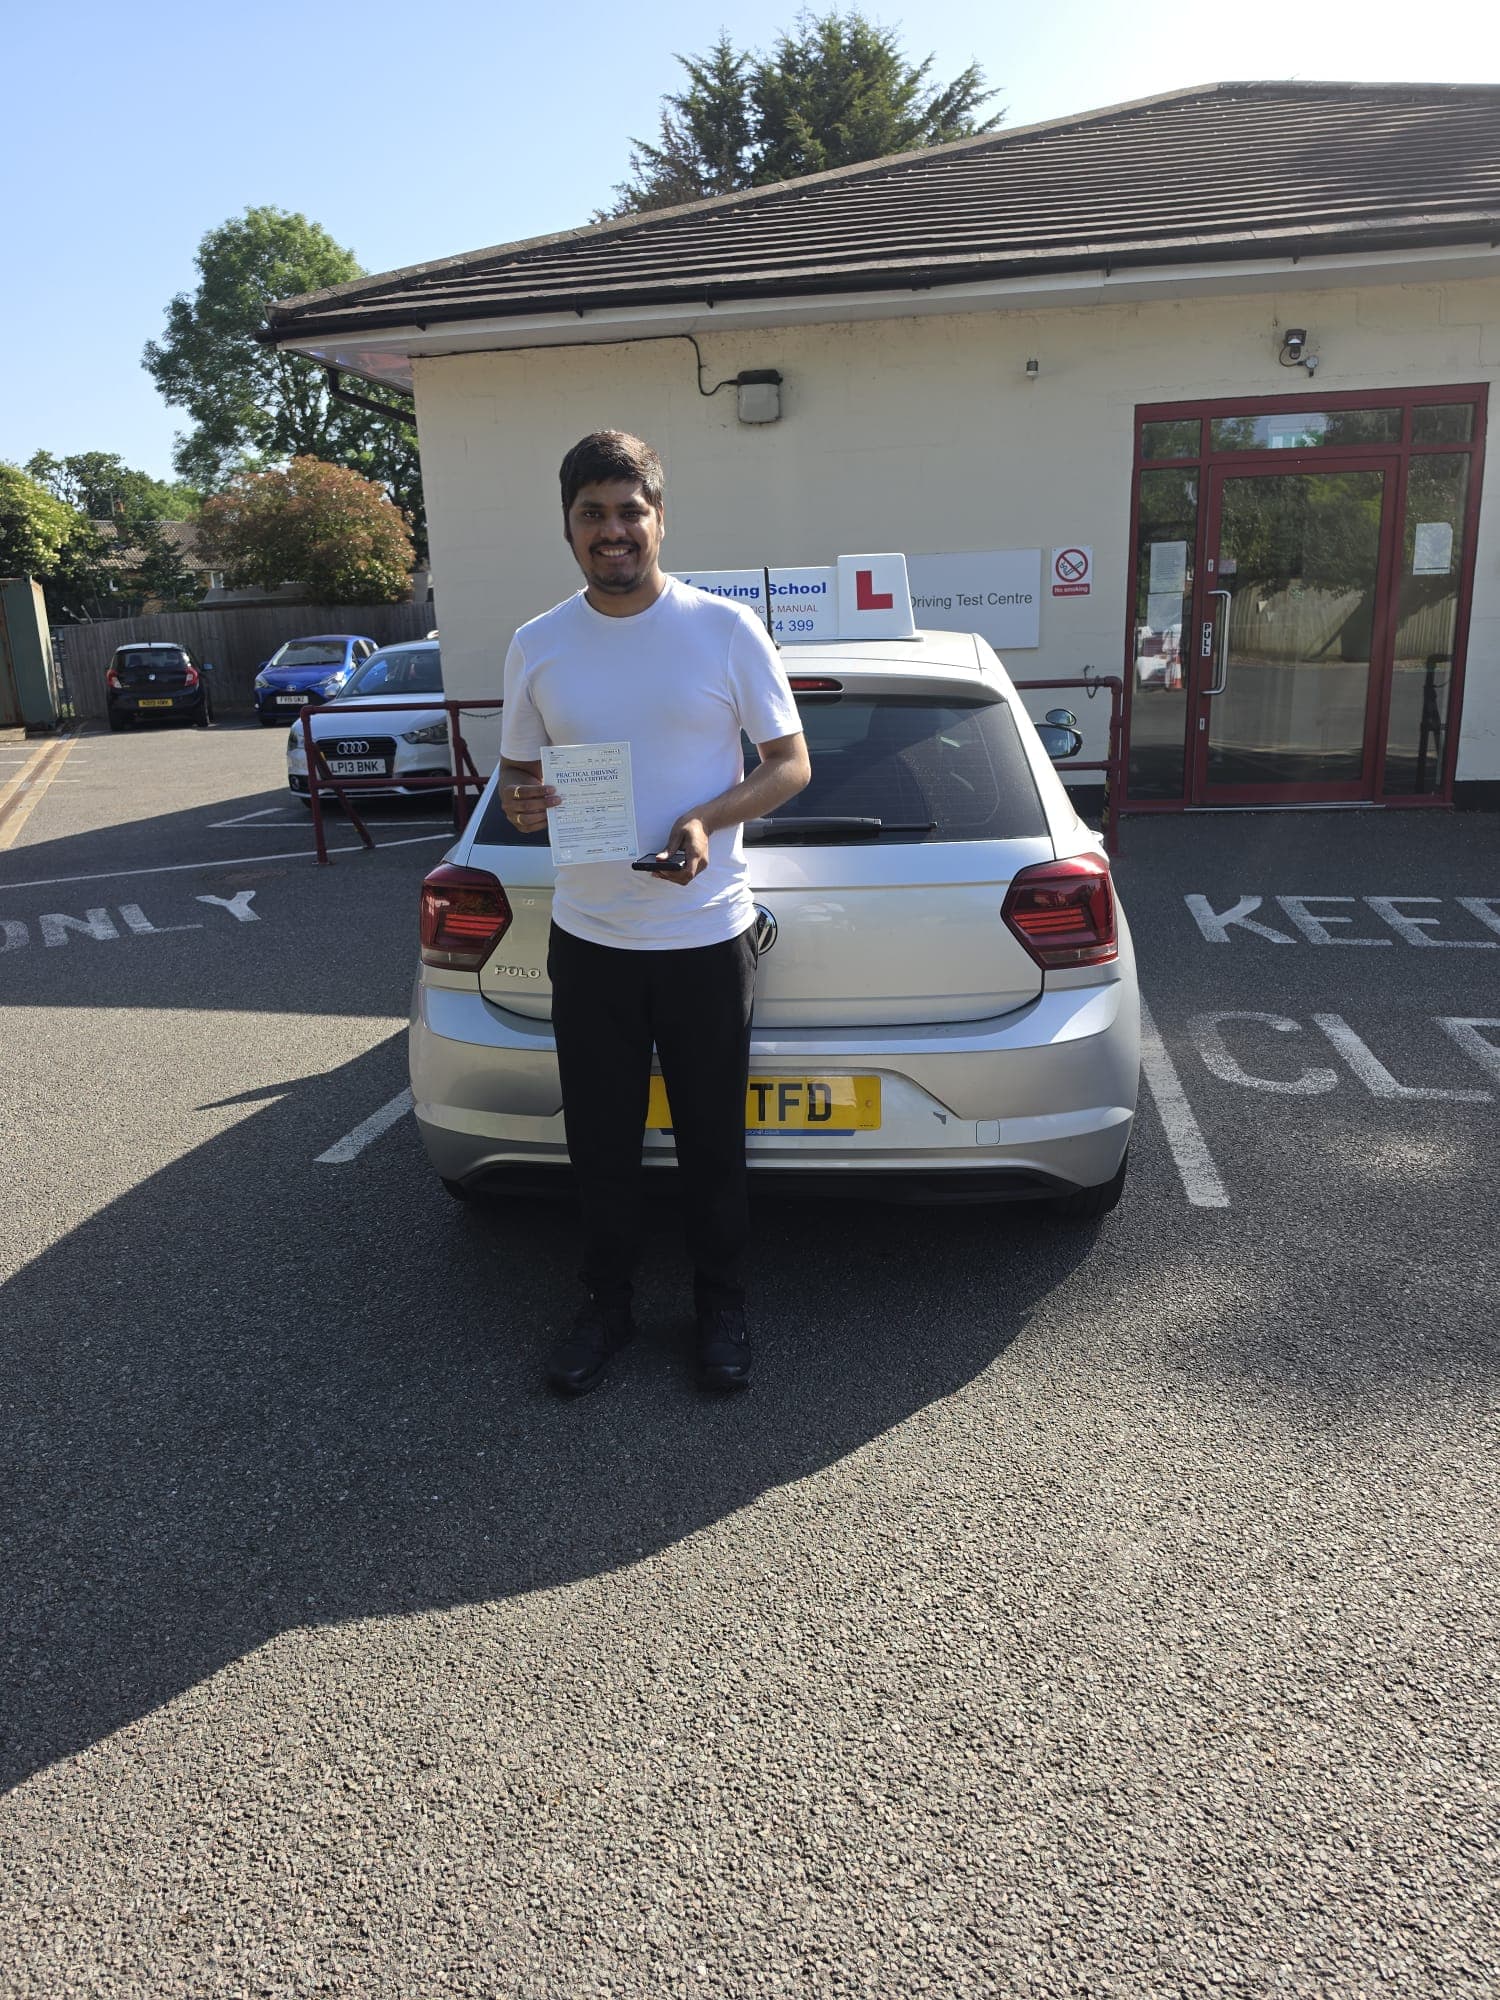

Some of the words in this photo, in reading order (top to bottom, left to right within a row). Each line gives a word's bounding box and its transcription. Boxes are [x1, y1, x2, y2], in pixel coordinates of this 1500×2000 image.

[768, 582, 827, 595] School
[856, 570, 893, 611] L
[911, 596, 952, 609] Driving
[956, 594, 983, 606] Test
[987, 592, 1033, 606] Centre
[777, 604, 818, 613] MANUAL
[788, 619, 814, 631] 399
[1203, 623, 1211, 655] PULL
[330, 761, 354, 773] LP13
[356, 760, 379, 772] BNK
[556, 771, 590, 779] PRACTICAL
[590, 769, 618, 777] DRIVING
[583, 774, 618, 782] CERTIFICATE
[494, 964, 541, 979] POLO
[750, 1083, 832, 1121] TFD
